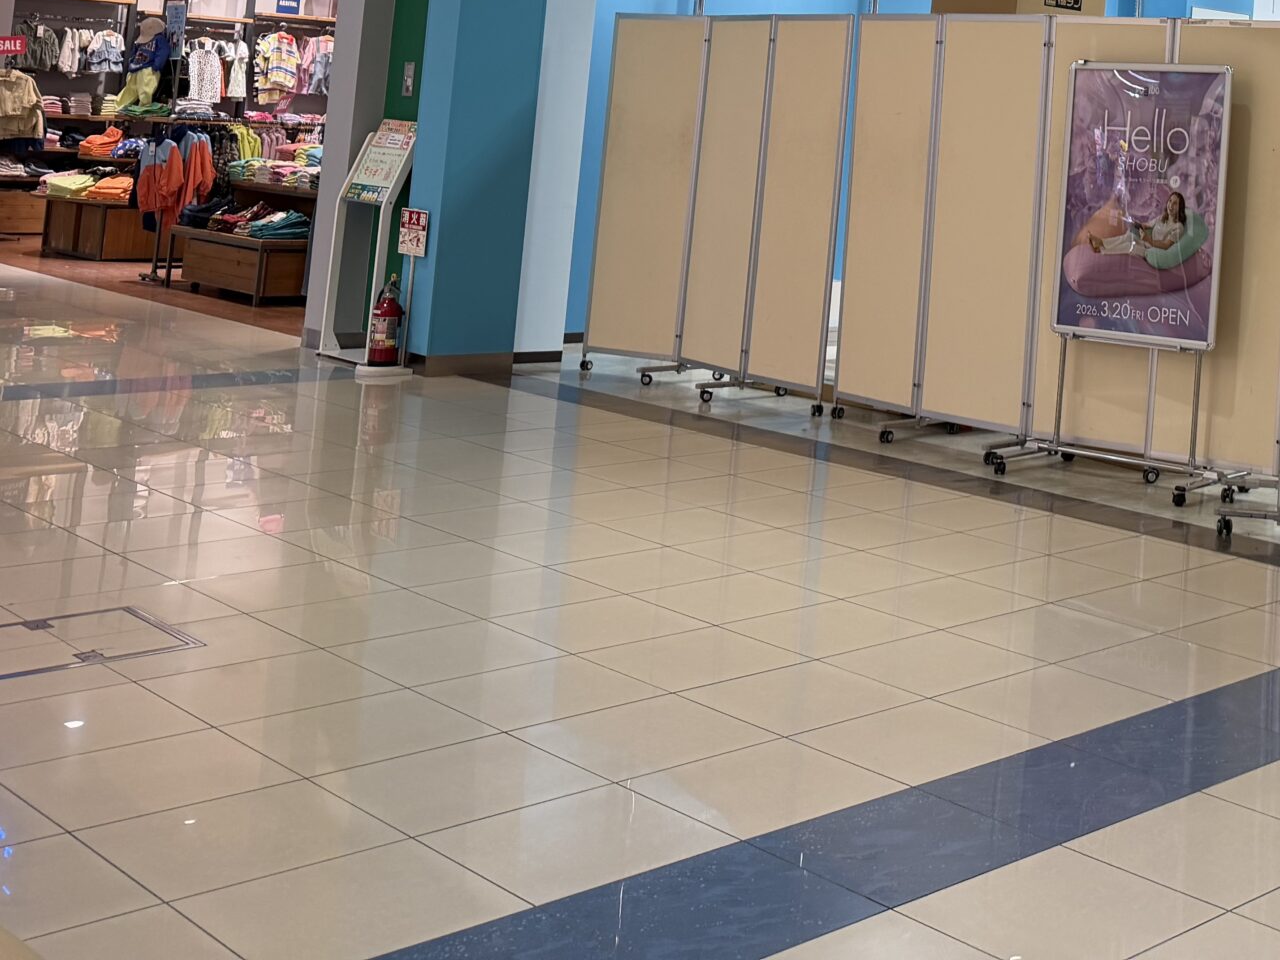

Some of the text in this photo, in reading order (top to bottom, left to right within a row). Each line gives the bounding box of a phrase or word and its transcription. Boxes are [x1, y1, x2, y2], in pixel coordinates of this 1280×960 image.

[1103, 107, 1189, 155] Hello
[1117, 156, 1169, 173] SHOBU
[1131, 309, 1144, 321] FRI
[1147, 305, 1191, 328] OPEN
